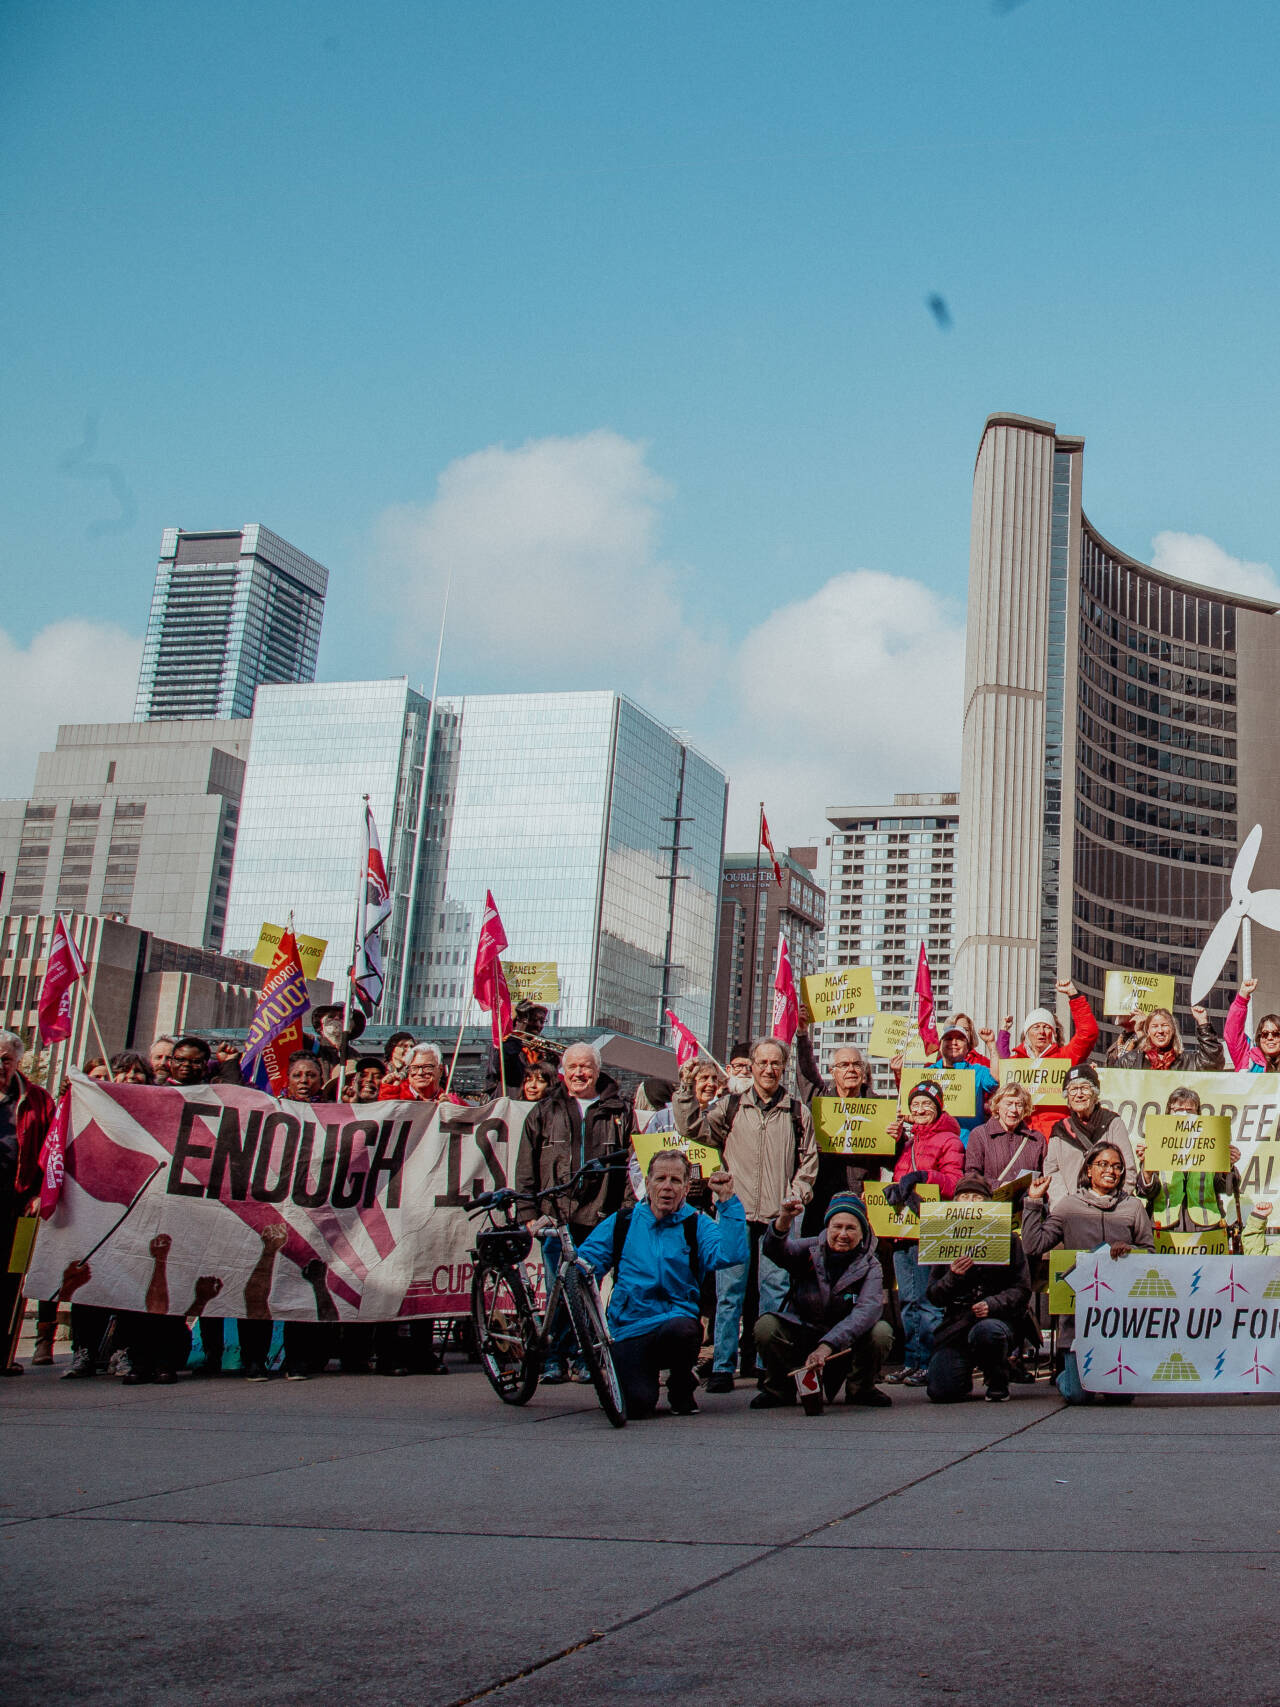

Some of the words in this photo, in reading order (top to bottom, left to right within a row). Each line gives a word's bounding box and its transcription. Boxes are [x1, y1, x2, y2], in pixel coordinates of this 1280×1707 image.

[509, 966, 536, 975] PANELS
[516, 979, 532, 988] NOT
[825, 974, 848, 987] MAKE
[1124, 976, 1158, 986] TURBINES
[510, 992, 542, 1001] IPELINES
[816, 987, 862, 1003] POLLUTERS
[1132, 988, 1147, 998] NOT
[826, 1004, 842, 1016] PAY
[844, 1002, 854, 1014] UP
[1006, 1070, 1048, 1084] POWER
[834, 1103, 878, 1115] TURBINES
[844, 1120, 862, 1131] NOT
[1175, 1120, 1202, 1132] MAKE
[828, 1136, 844, 1148] TAR
[846, 1136, 876, 1148] SANDS
[1161, 1137, 1216, 1150] POLLUTERS
[166, 1102, 414, 1210] ENOUGH
[1171, 1154, 1194, 1166] PAY
[1194, 1154, 1206, 1166] UP
[888, 1213, 904, 1224] FOR
[904, 1213, 918, 1225] ALL
[946, 1208, 983, 1220] PANELS
[952, 1226, 974, 1239] NOT
[938, 1245, 988, 1258] PIPELINES
[1082, 1306, 1181, 1340] POWER
[1186, 1307, 1222, 1340] UP
